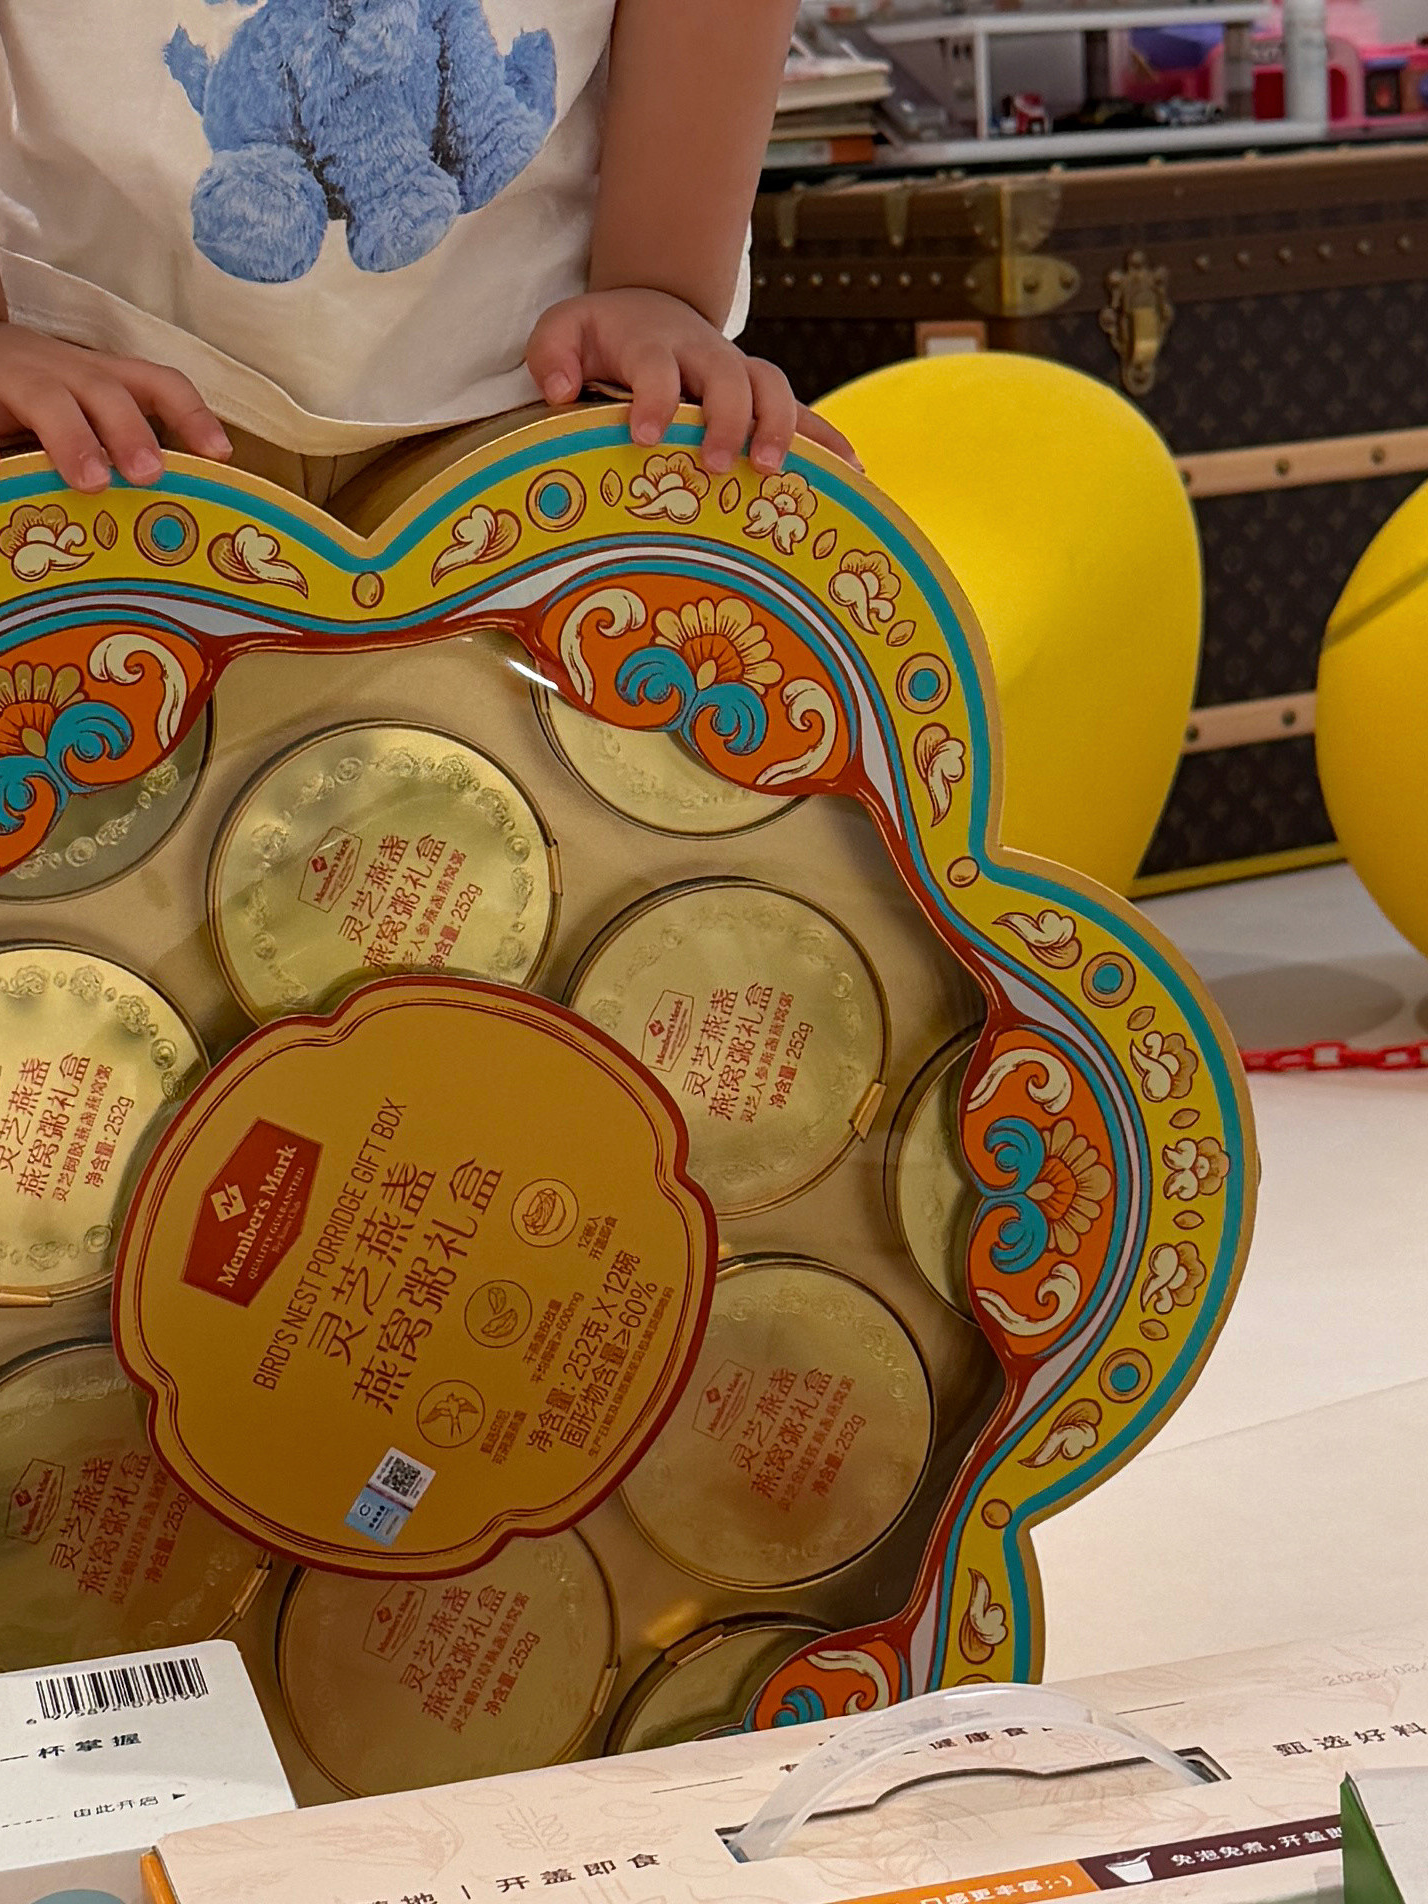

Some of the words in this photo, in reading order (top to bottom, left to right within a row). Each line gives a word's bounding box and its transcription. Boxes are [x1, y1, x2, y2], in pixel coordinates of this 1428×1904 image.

[337, 831, 409, 946] 灵芝燕盏
[360, 830, 447, 974] 燕窝粥礼盒
[681, 984, 738, 1098] 灵芝燕盏
[705, 980, 773, 1122] 燕窝粥礼盒
[13, 1048, 91, 1201] 燕窝粥礼盒
[214, 1194, 273, 1288] Member's
[257, 1139, 298, 1198] Mark
[245, 1235, 274, 1280] QUALITY
[267, 1165, 307, 1234] GUARANTEED
[251, 1325, 300, 1392] BIRD'S
[279, 1274, 324, 1331] NEST
[304, 1180, 368, 1278] PORRIDGE
[348, 1137, 388, 1186] GIFT
[370, 1096, 407, 1140] BOX
[301, 1152, 441, 1367] 灵芝燕盏
[345, 1151, 510, 1417] 燕窝粥礼盒
[728, 1363, 798, 1473] 灵芝燕盏
[749, 1364, 833, 1500] 燕窝粥礼盒
[48, 1450, 114, 1573] 灵芝燕盏
[75, 1446, 152, 1599] 燕窝粥礼盒
[399, 1581, 471, 1694] 灵芝燕盏
[419, 1581, 506, 1722] 燕窝粥礼盒
[73, 1796, 159, 1819] 由此开启
[1273, 1721, 1427, 1758] 甄选好料
[496, 1851, 661, 1894] 开盖即食
